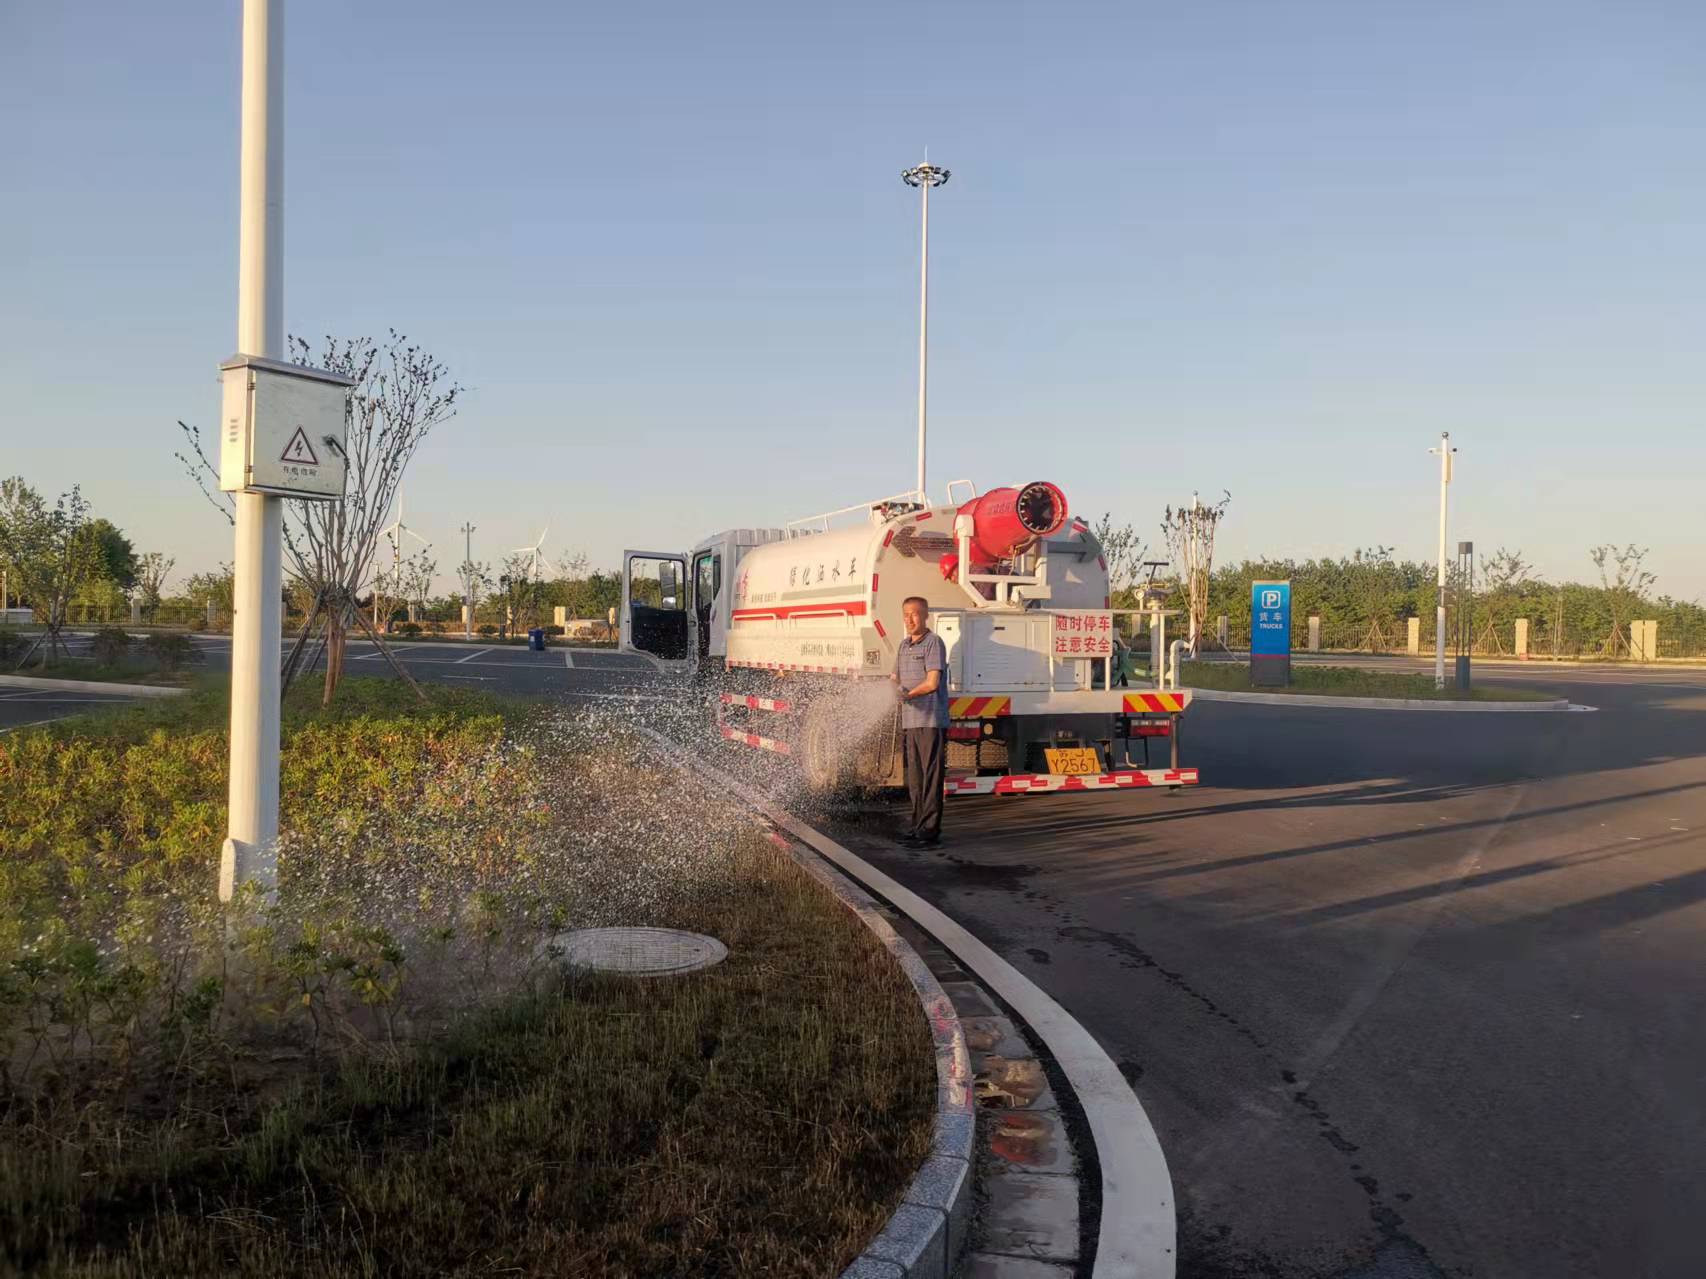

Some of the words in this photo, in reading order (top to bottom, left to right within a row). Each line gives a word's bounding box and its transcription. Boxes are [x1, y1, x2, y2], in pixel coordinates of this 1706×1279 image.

[1056, 615, 1110, 632] 随时停车
[1260, 612, 1282, 622] 货车
[1056, 636, 1110, 653] 注意安全
[1051, 758, 1096, 773] Y2567
